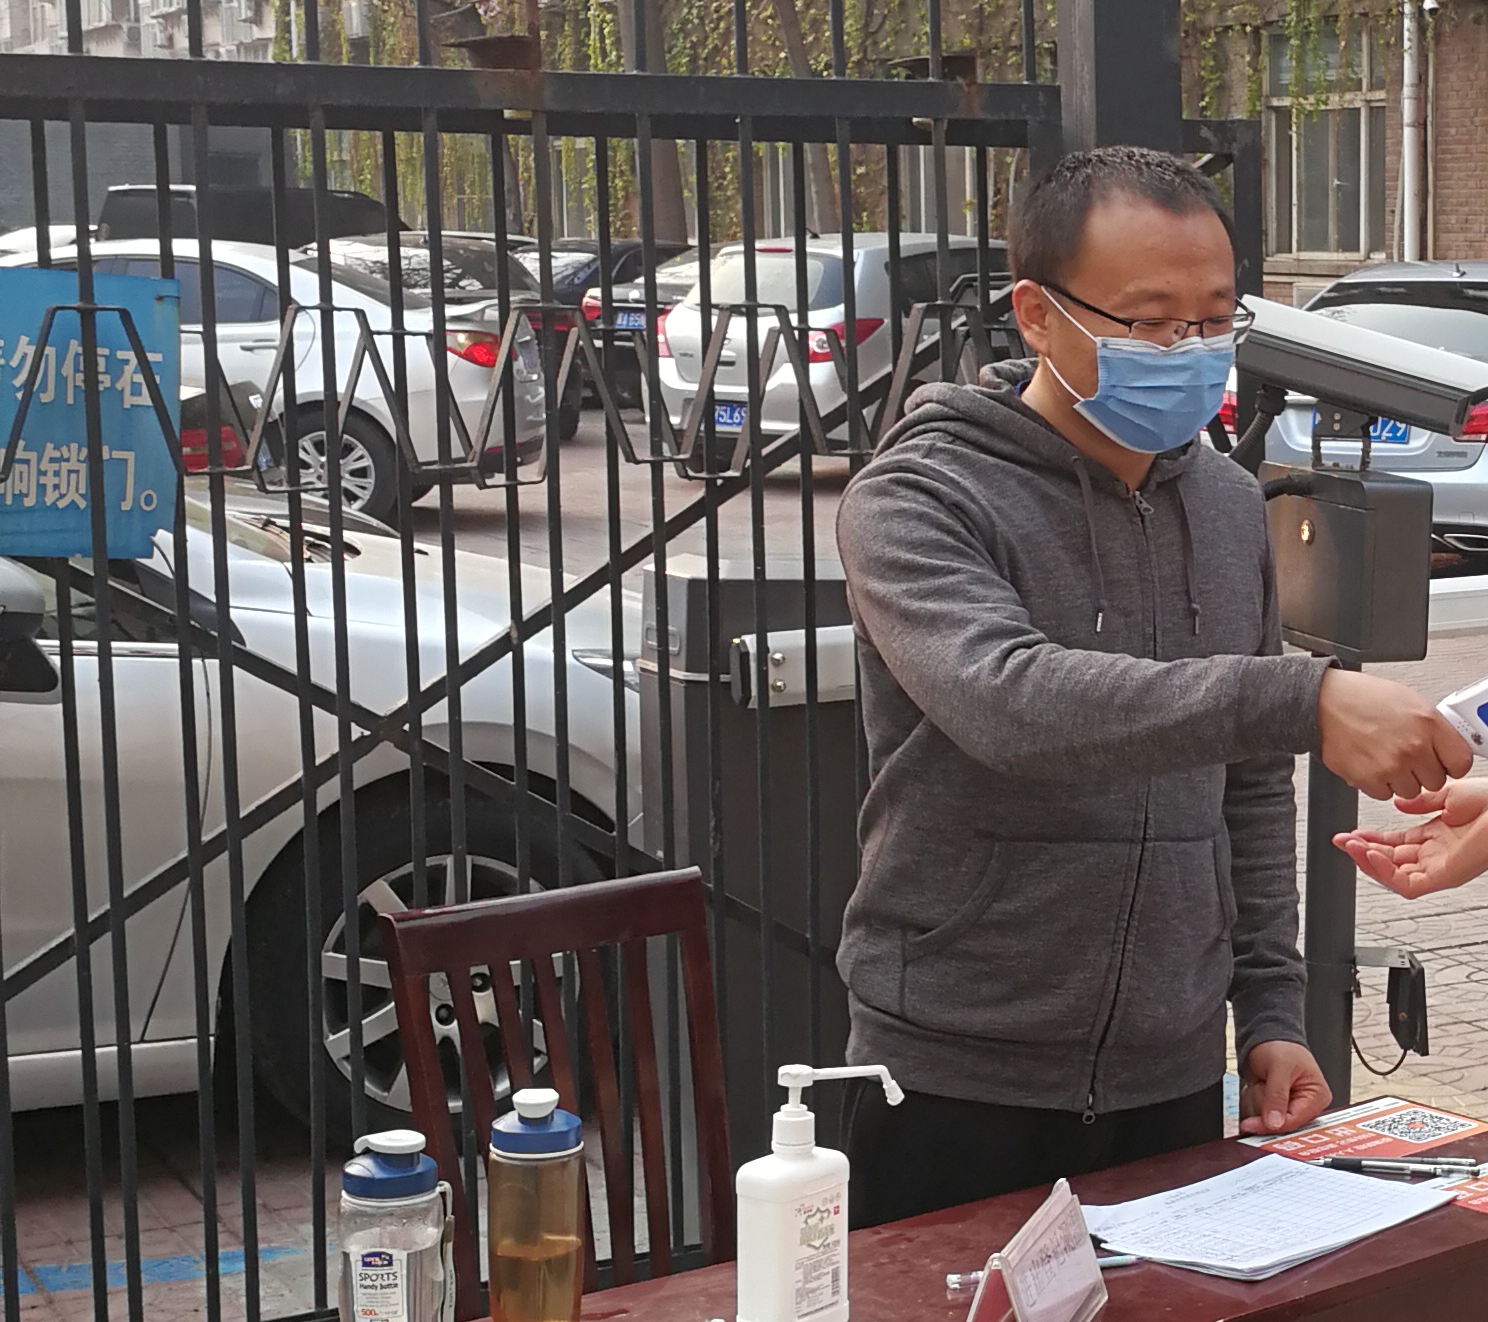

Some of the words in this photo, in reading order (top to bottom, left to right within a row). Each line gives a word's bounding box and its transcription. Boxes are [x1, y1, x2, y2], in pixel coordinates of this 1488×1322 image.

[0, 335, 163, 409] 勿停在
[358, 1271, 399, 1283] SPORTS
